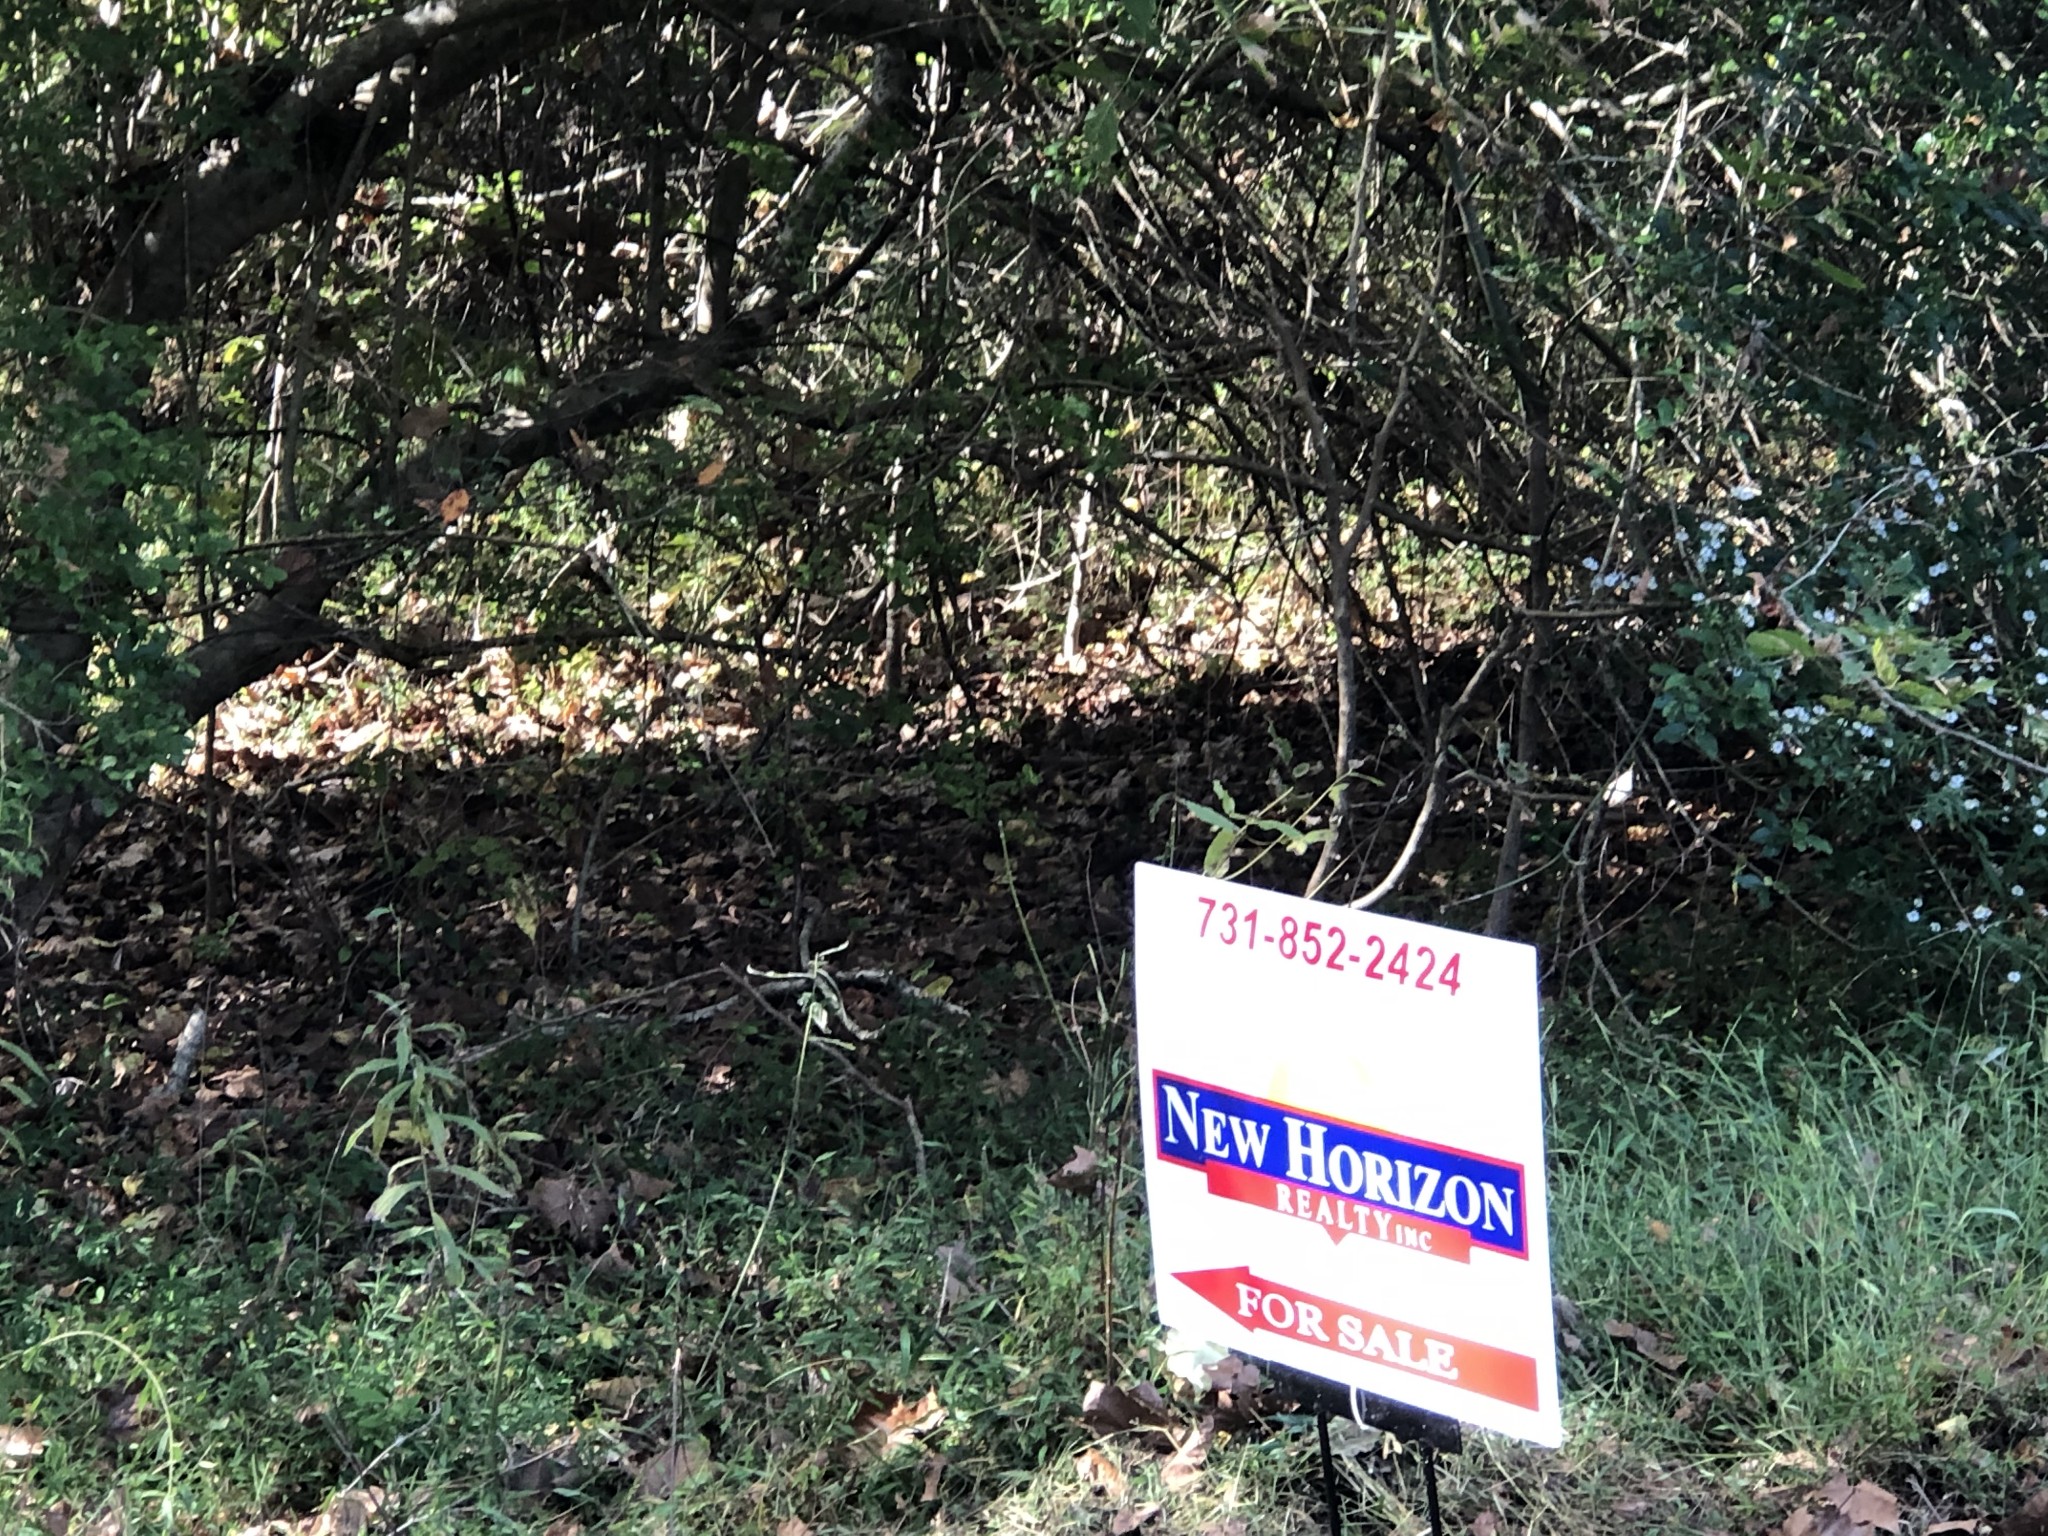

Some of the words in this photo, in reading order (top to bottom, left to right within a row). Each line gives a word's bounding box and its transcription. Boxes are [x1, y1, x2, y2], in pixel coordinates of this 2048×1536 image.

[1199, 896, 1460, 996] 731-852-2424
[1162, 1084, 1270, 1168] NEW
[1283, 1116, 1515, 1236] HORIZON
[1275, 1183, 1392, 1242] REALTY
[1395, 1223, 1432, 1252] INC
[1236, 1282, 1330, 1342] FOR
[1338, 1314, 1459, 1380] SALE
